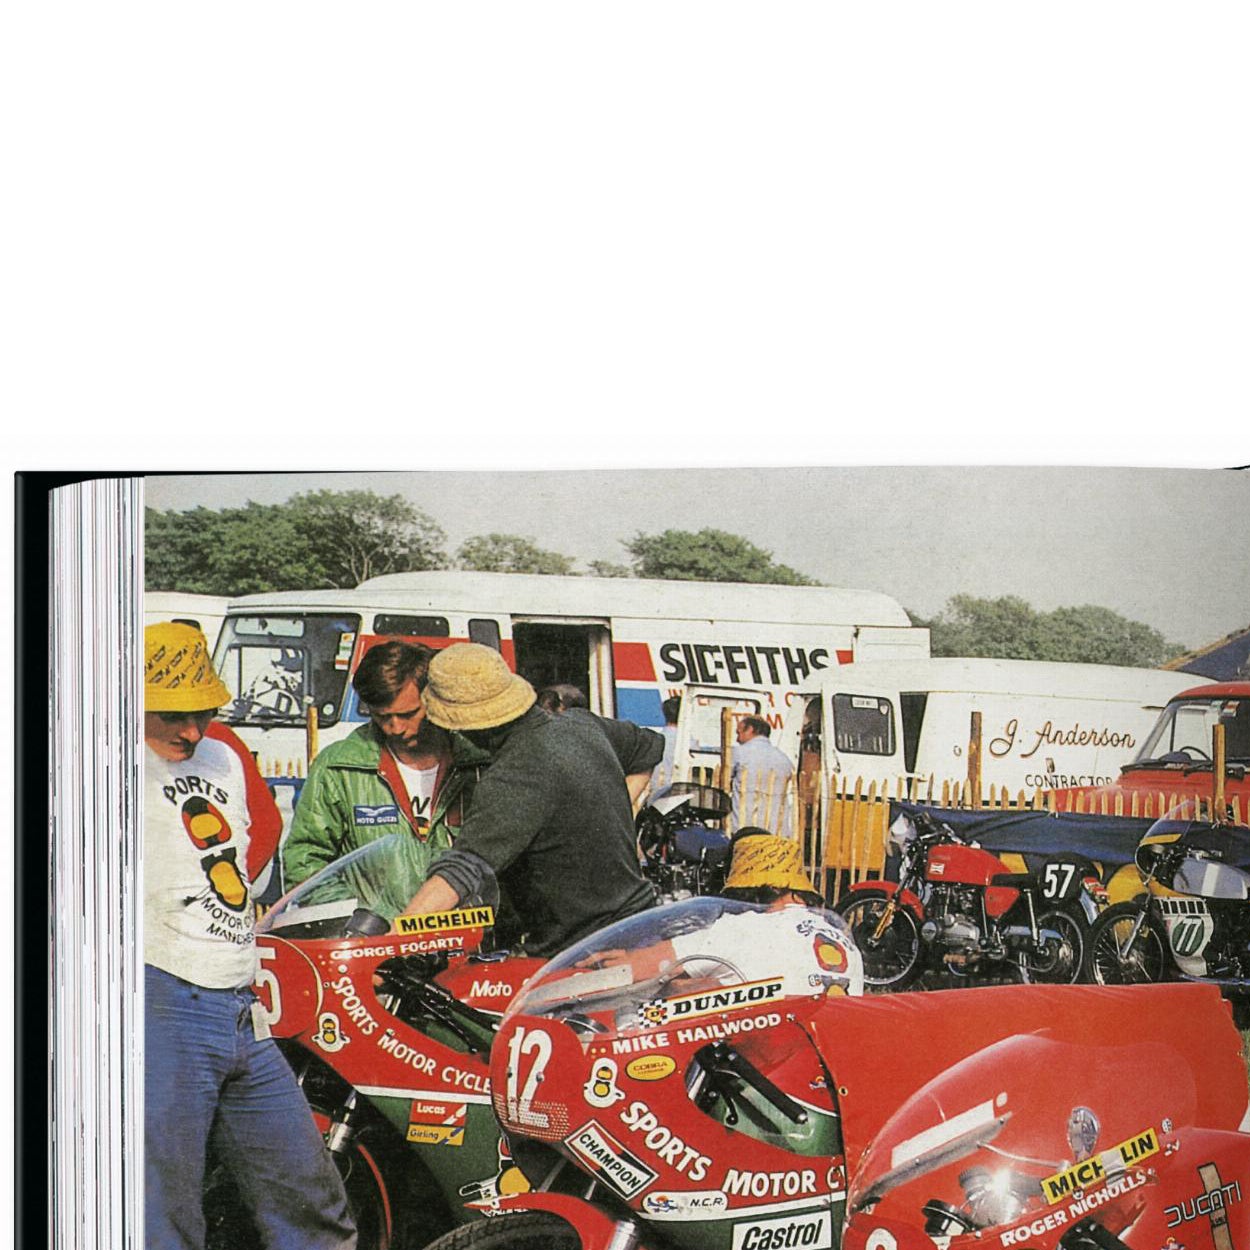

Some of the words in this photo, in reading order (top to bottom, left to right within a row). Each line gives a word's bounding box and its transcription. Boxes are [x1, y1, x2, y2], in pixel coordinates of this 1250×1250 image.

[1020, 720, 1137, 758] Anderson
[1043, 863, 1076, 899] 57
[400, 910, 490, 932] MICHELIN
[330, 945, 394, 960] GEORGE
[400, 936, 465, 954] FOGARTY
[470, 979, 512, 998] Moto
[672, 982, 782, 1016] DUNLOP
[331, 976, 379, 1036] SPORTS
[377, 1032, 438, 1076] MOTOR
[612, 1032, 670, 1055] MIKE
[677, 1013, 782, 1044] HAILWOOD
[506, 1026, 553, 1129] 12
[416, 1103, 446, 1114] Lucas
[409, 1128, 439, 1140] Girling
[619, 1101, 713, 1182] SPORTS
[722, 1168, 817, 1197] MOTOR
[578, 1132, 642, 1189] CHAMPION
[1048, 1133, 1155, 1199] MICHLIN
[690, 1197, 725, 1207] N.C.R.
[1000, 1210, 1069, 1249] ROGER
[1068, 1170, 1147, 1219] NICHOLLS
[1163, 1180, 1242, 1228] DUCATI
